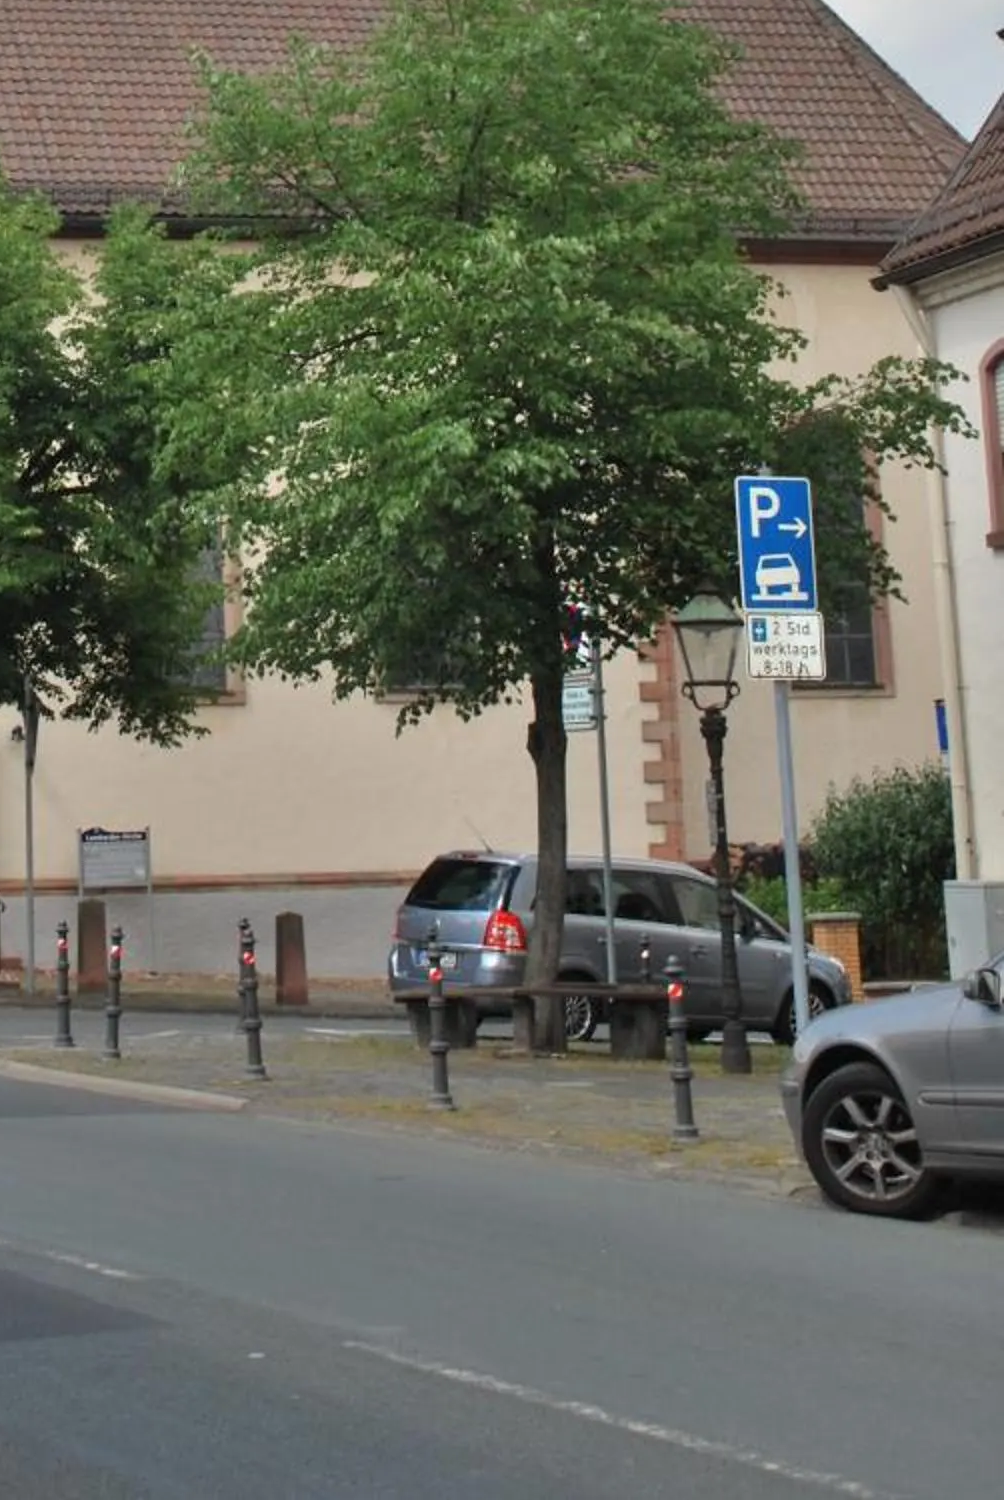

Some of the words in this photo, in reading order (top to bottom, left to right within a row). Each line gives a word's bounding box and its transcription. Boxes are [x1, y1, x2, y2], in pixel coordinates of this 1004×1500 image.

[749, 486, 781, 538] P
[772, 620, 781, 636] 2
[787, 620, 811, 636] Std
[753, 641, 818, 660] werktags
[763, 659, 793, 675] 8-18
